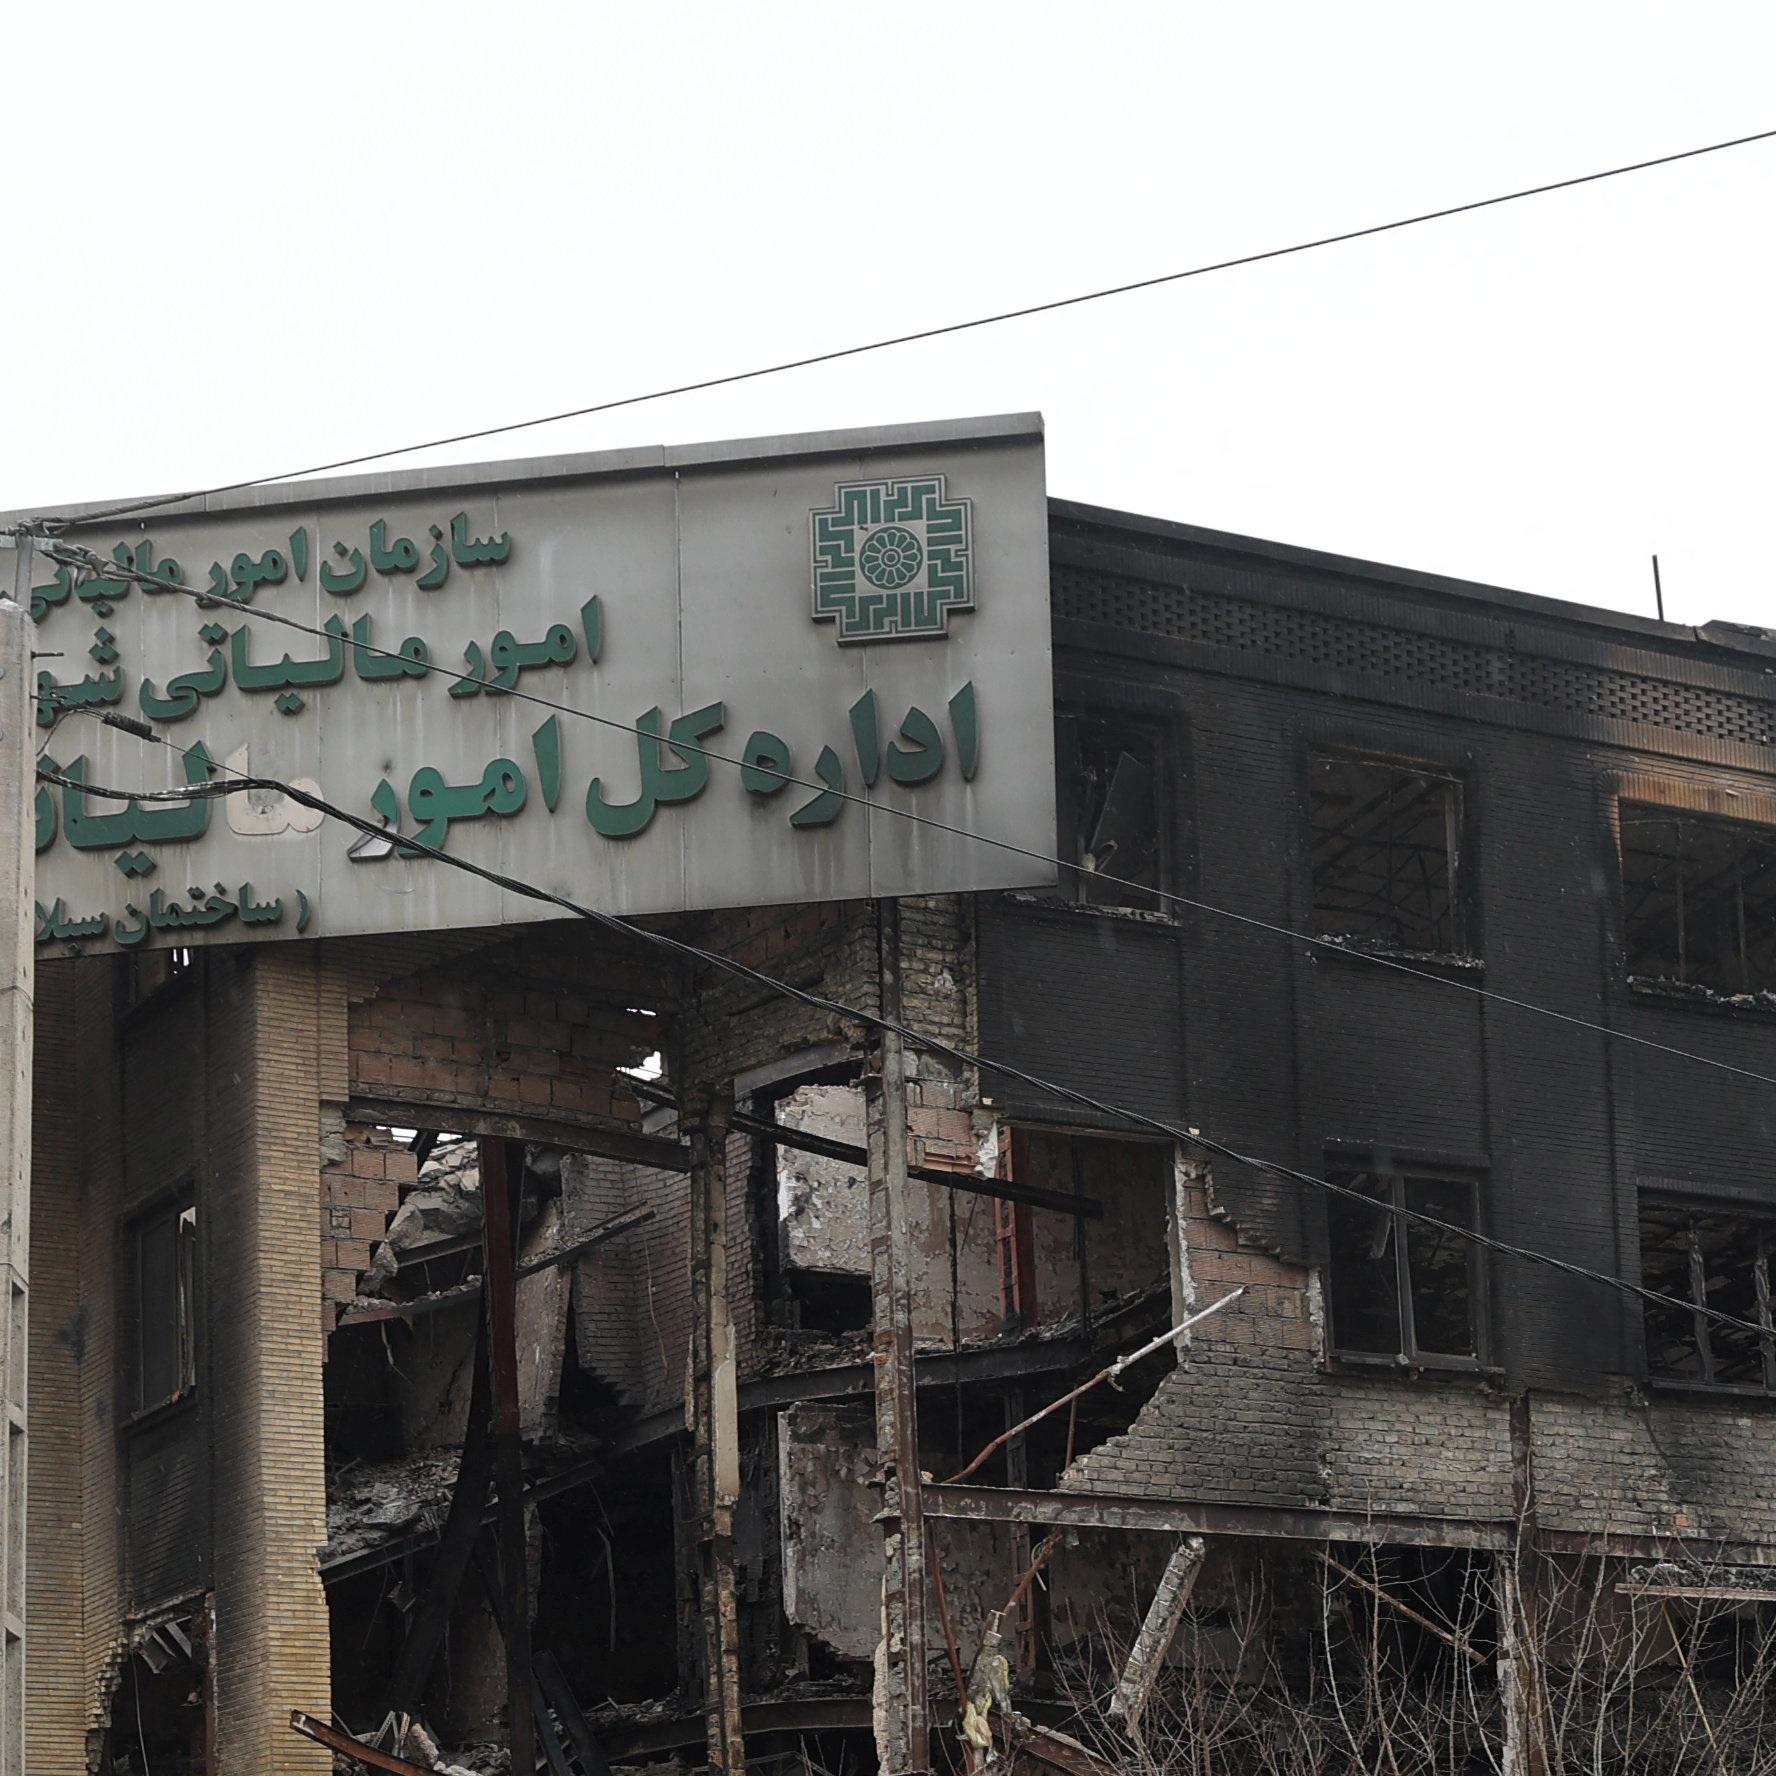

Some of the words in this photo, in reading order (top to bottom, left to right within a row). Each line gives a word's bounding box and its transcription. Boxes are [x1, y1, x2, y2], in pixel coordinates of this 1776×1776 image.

[195, 526, 309, 608] امور
[319, 511, 513, 596] سازمان
[36, 626, 124, 728] شه
[139, 612, 431, 722] مالیاتی
[448, 594, 606, 699] امور
[347, 714, 563, 862] امور
[586, 701, 724, 840] کل
[741, 680, 980, 828] اداره
